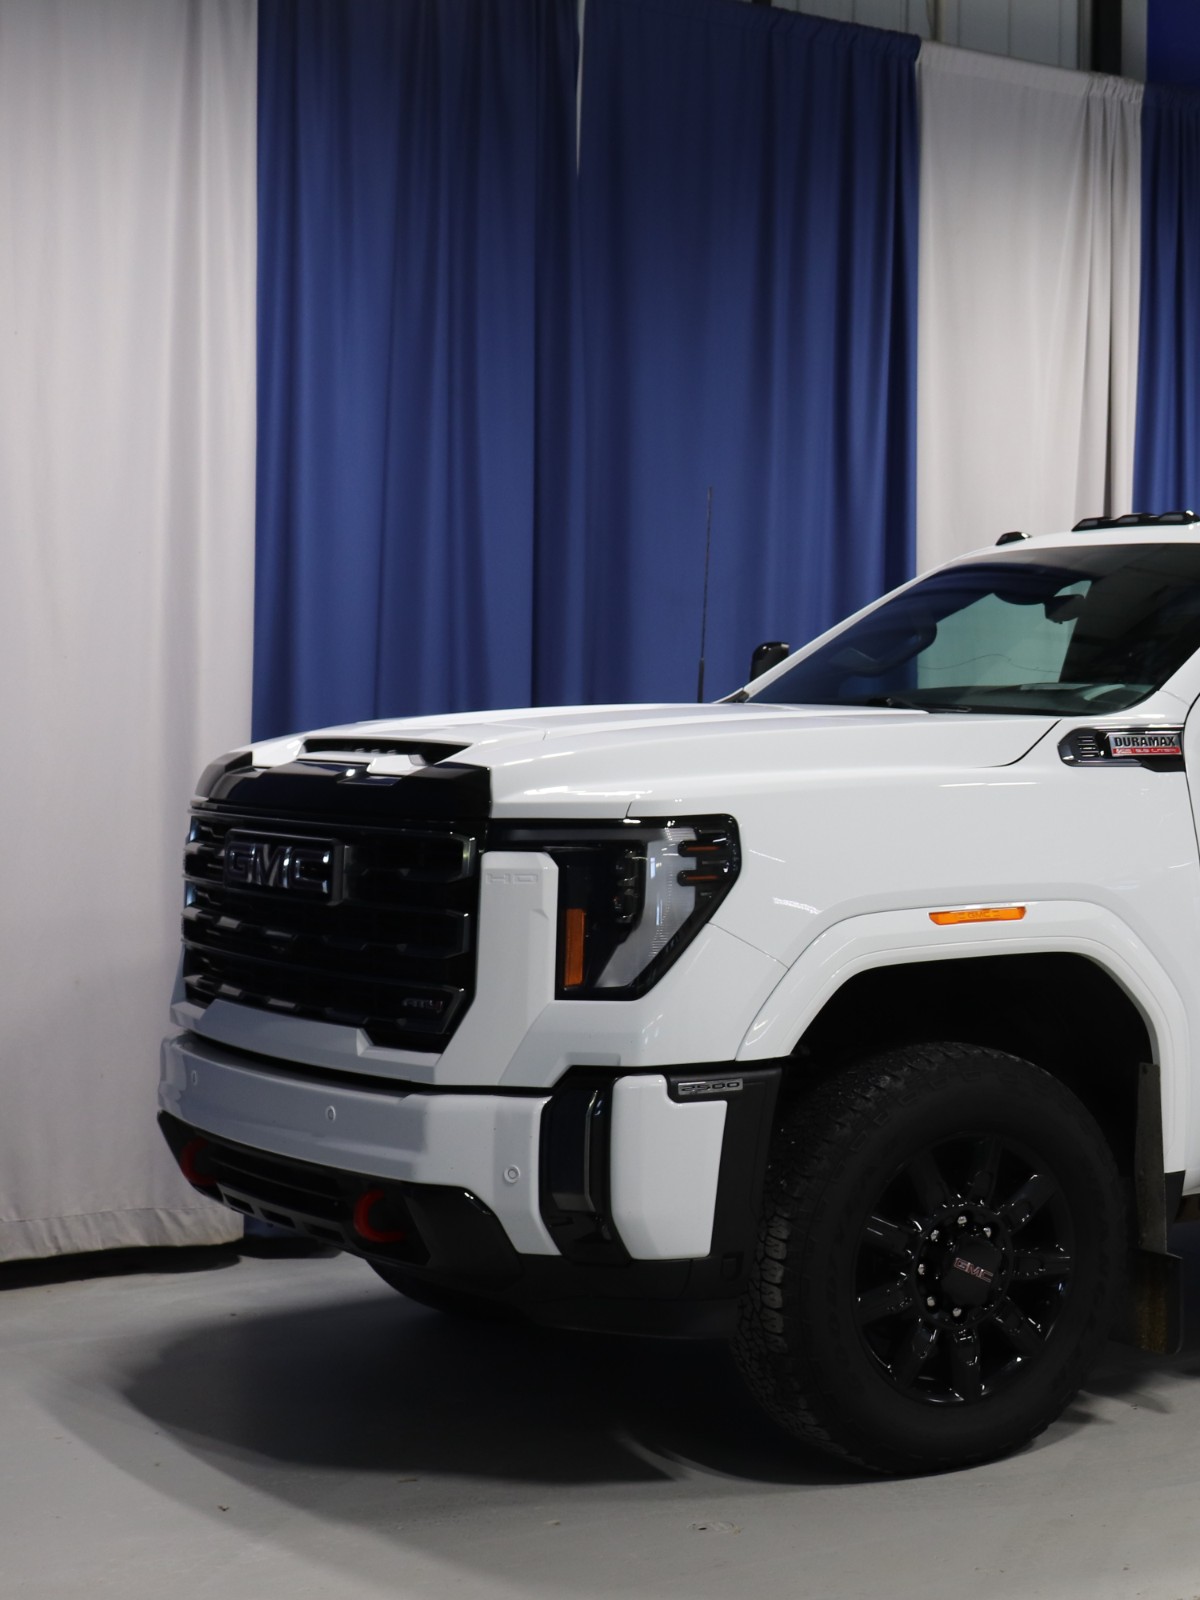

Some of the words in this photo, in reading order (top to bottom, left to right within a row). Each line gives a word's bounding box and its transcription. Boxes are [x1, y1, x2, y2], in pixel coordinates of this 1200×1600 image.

[1114, 736, 1176, 747] DURAMAX
[226, 840, 331, 895] GMC
[485, 872, 539, 885] HD
[401, 998, 444, 1013] AT4
[681, 1081, 740, 1092] 2500
[953, 1257, 994, 1283] GMC
